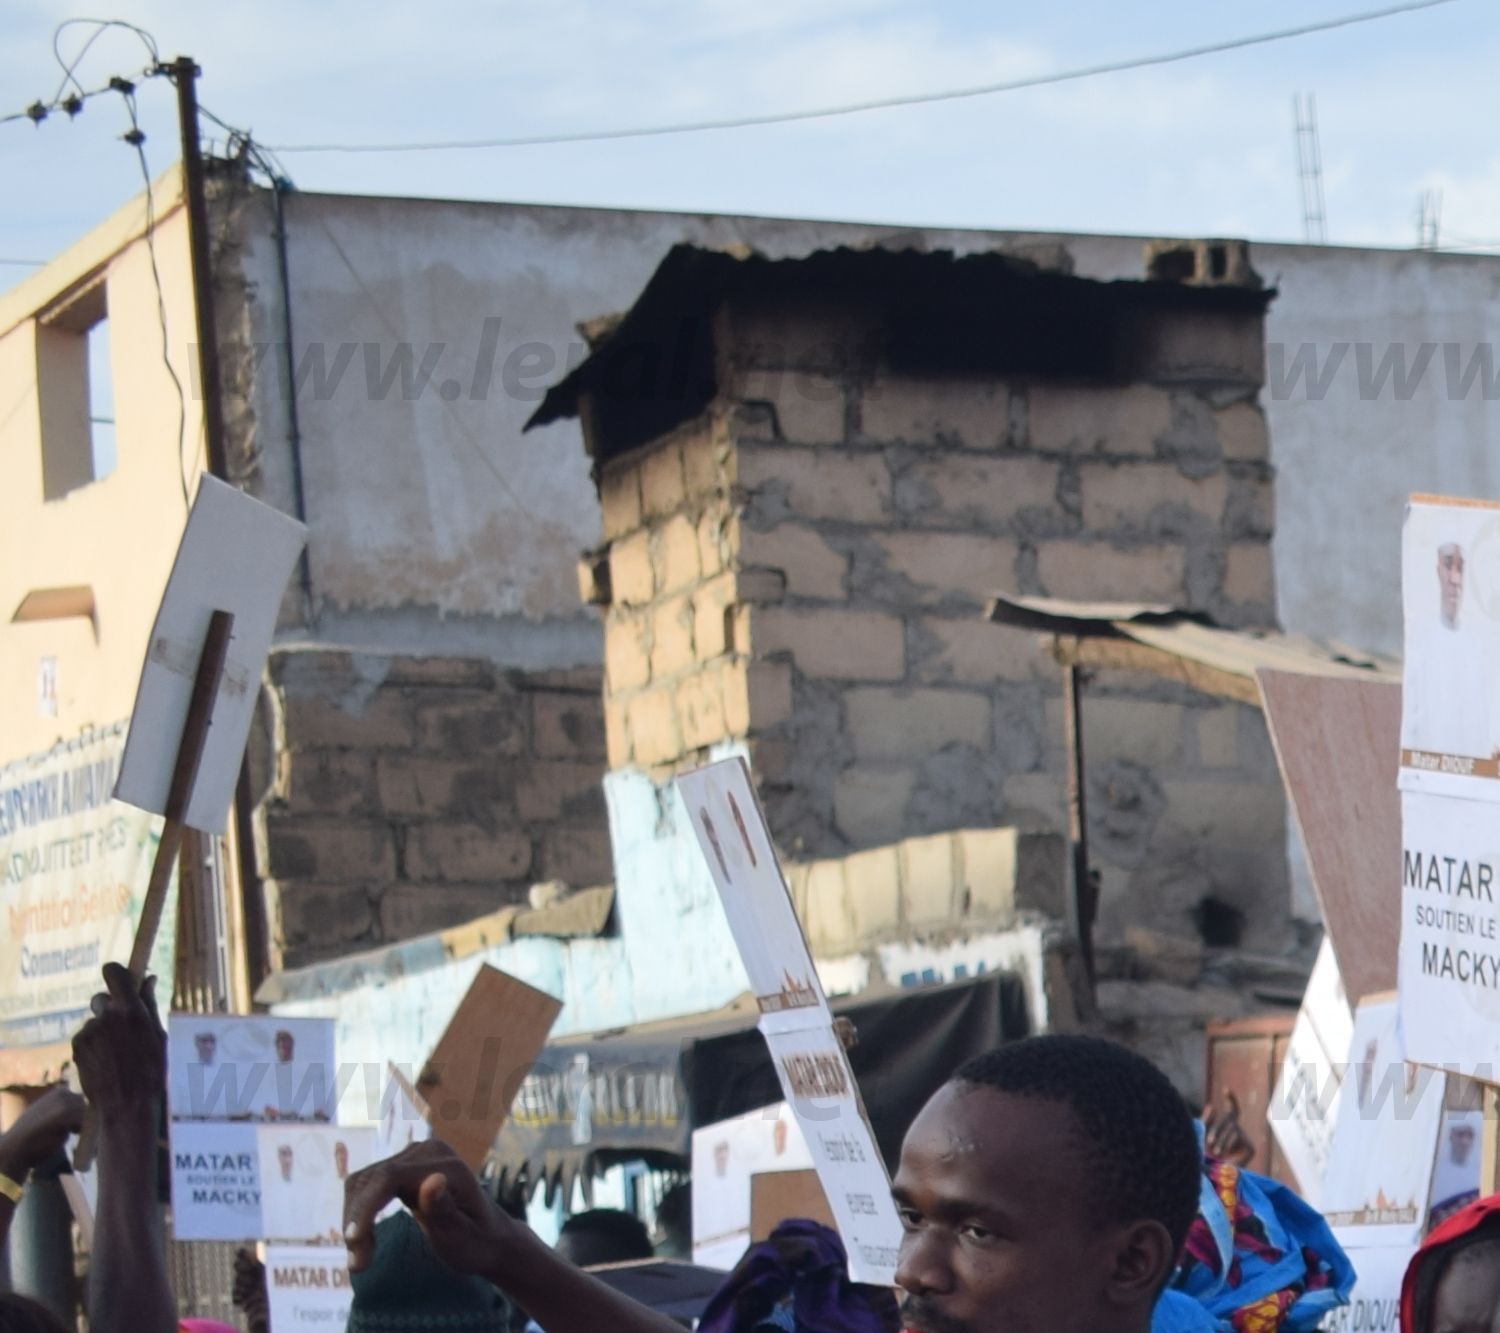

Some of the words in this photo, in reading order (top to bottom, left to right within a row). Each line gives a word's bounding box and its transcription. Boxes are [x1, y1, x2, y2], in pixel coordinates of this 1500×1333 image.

[1403, 849, 1493, 905] MATAR
[1415, 904, 1475, 938] SOUTIEN
[1480, 916, 1496, 940] LE
[175, 1154, 252, 1171] MATAR
[192, 1190, 261, 1205] MACKY
[273, 1267, 329, 1289] MATAR
